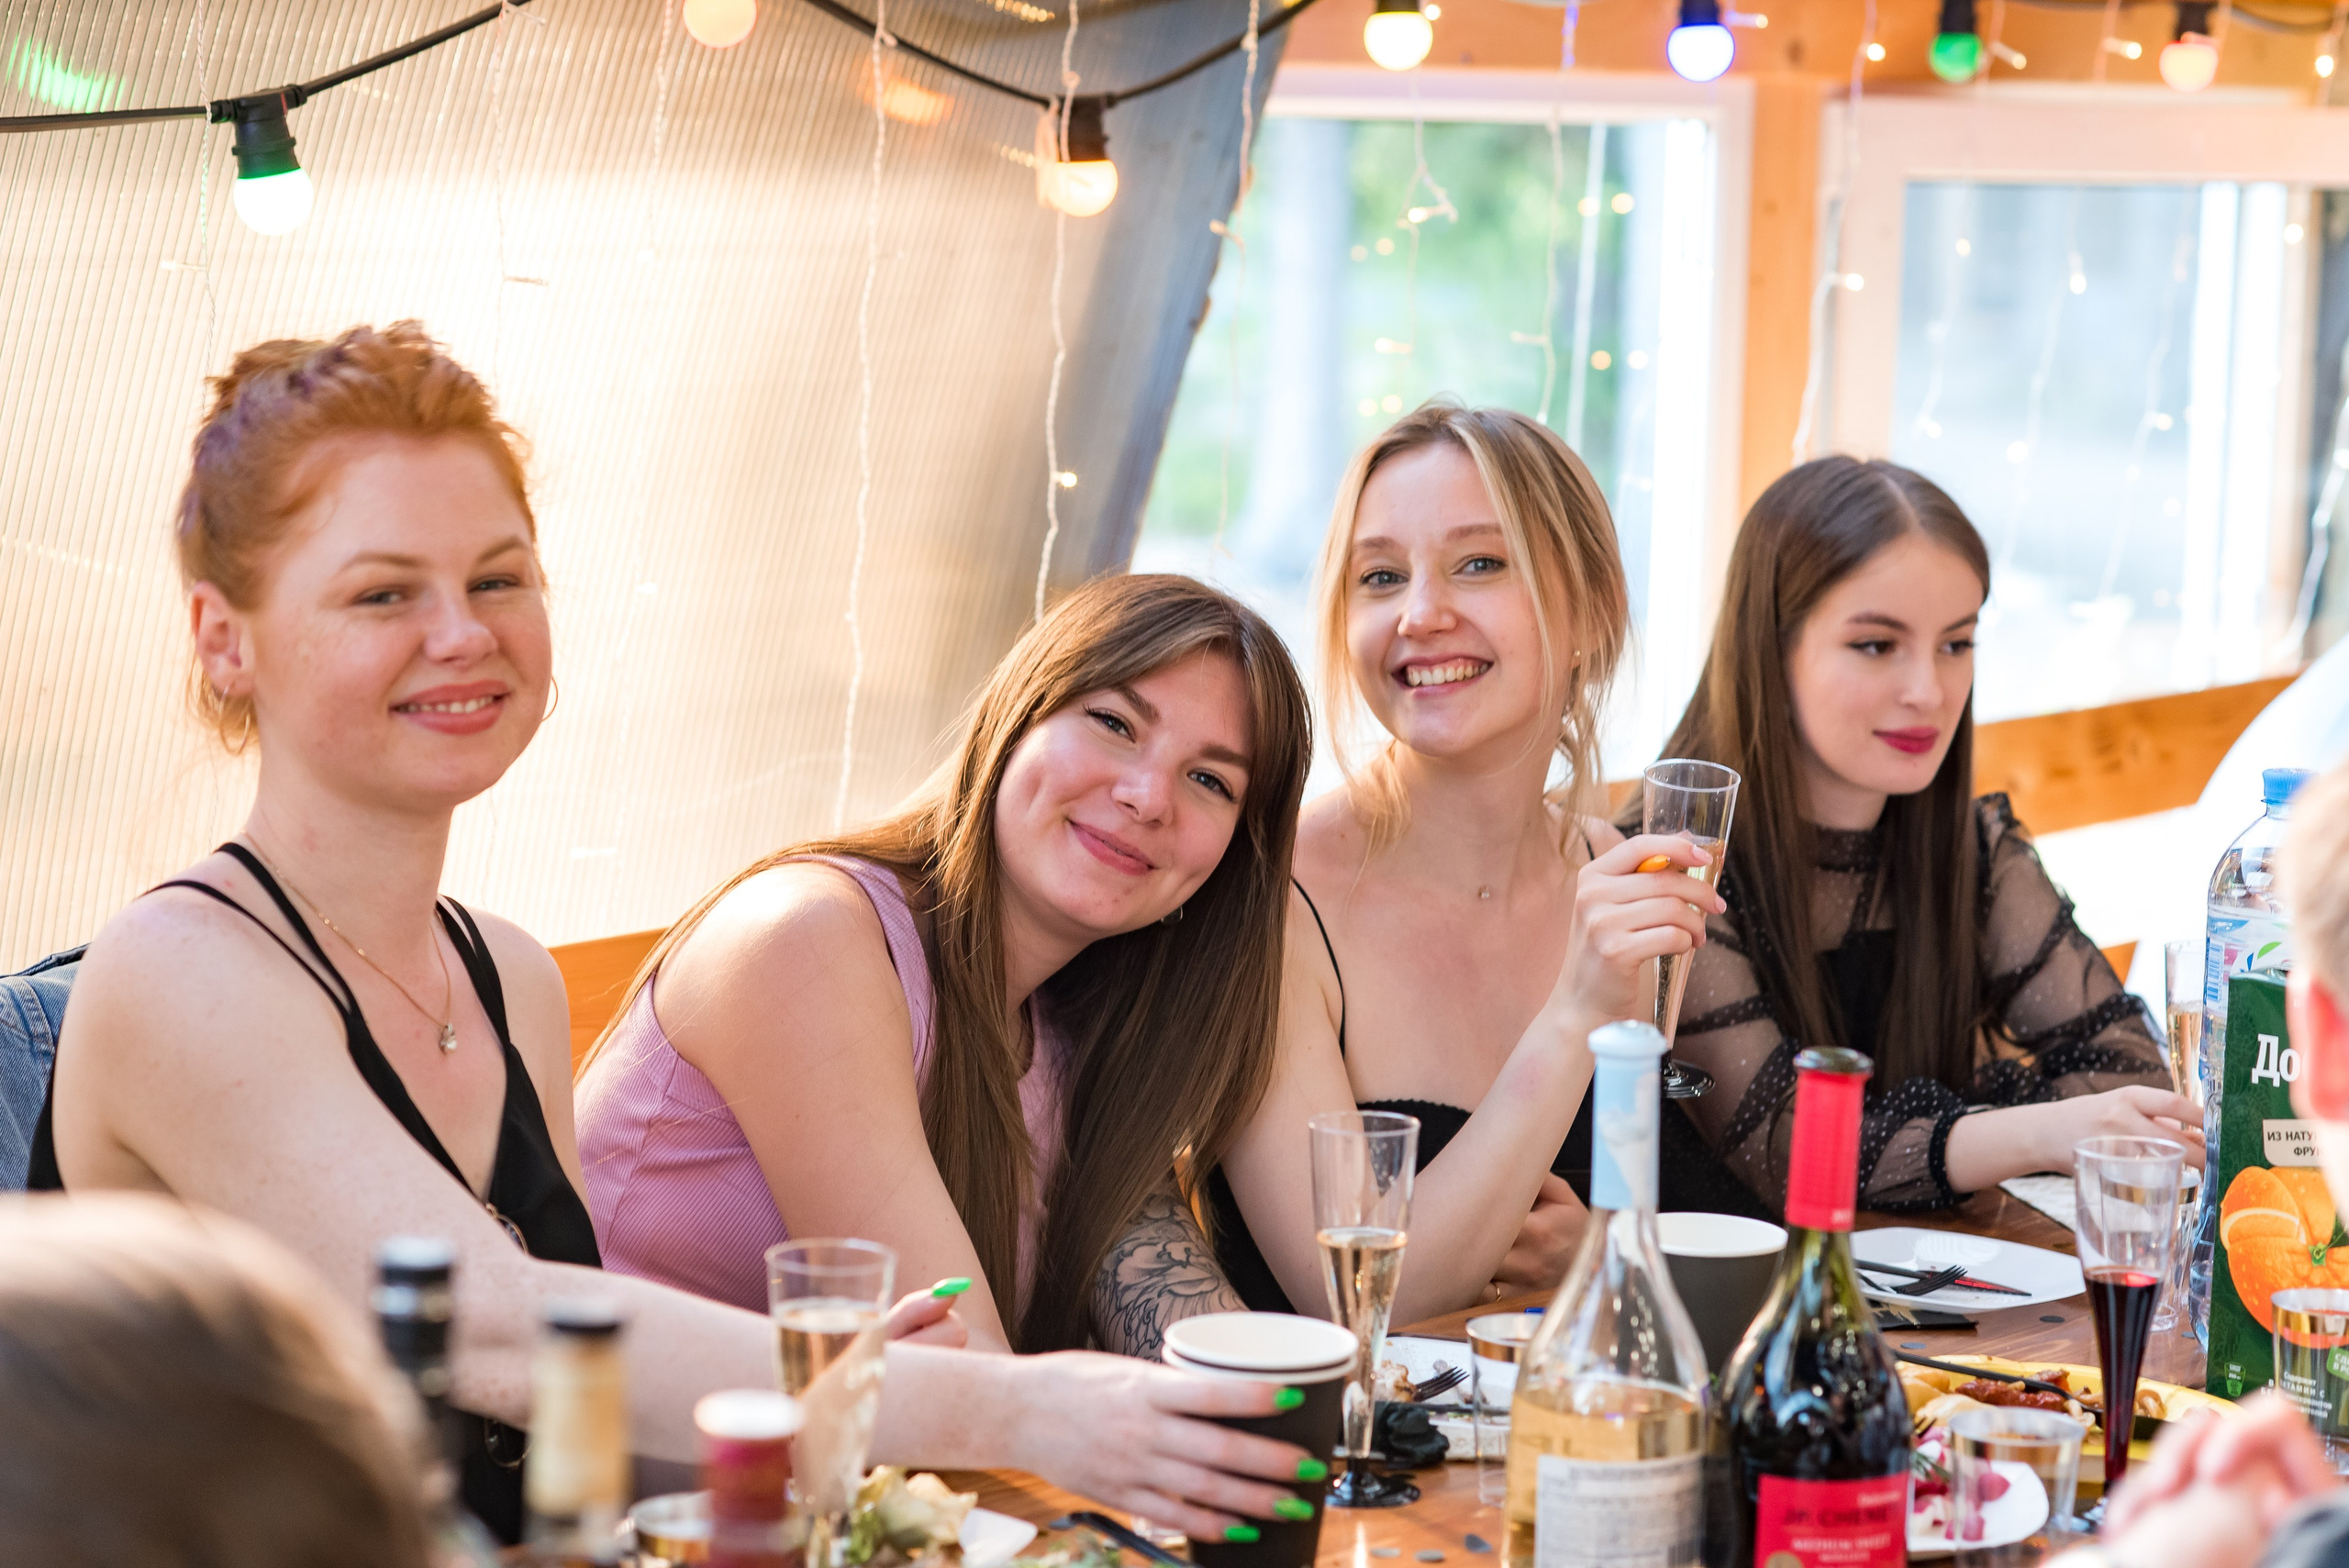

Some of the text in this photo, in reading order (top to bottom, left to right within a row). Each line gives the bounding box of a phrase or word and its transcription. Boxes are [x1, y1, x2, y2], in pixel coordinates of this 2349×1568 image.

[2251, 1033, 2308, 1088] До
[2266, 1130, 2317, 1141] ИЗ НАТУ
